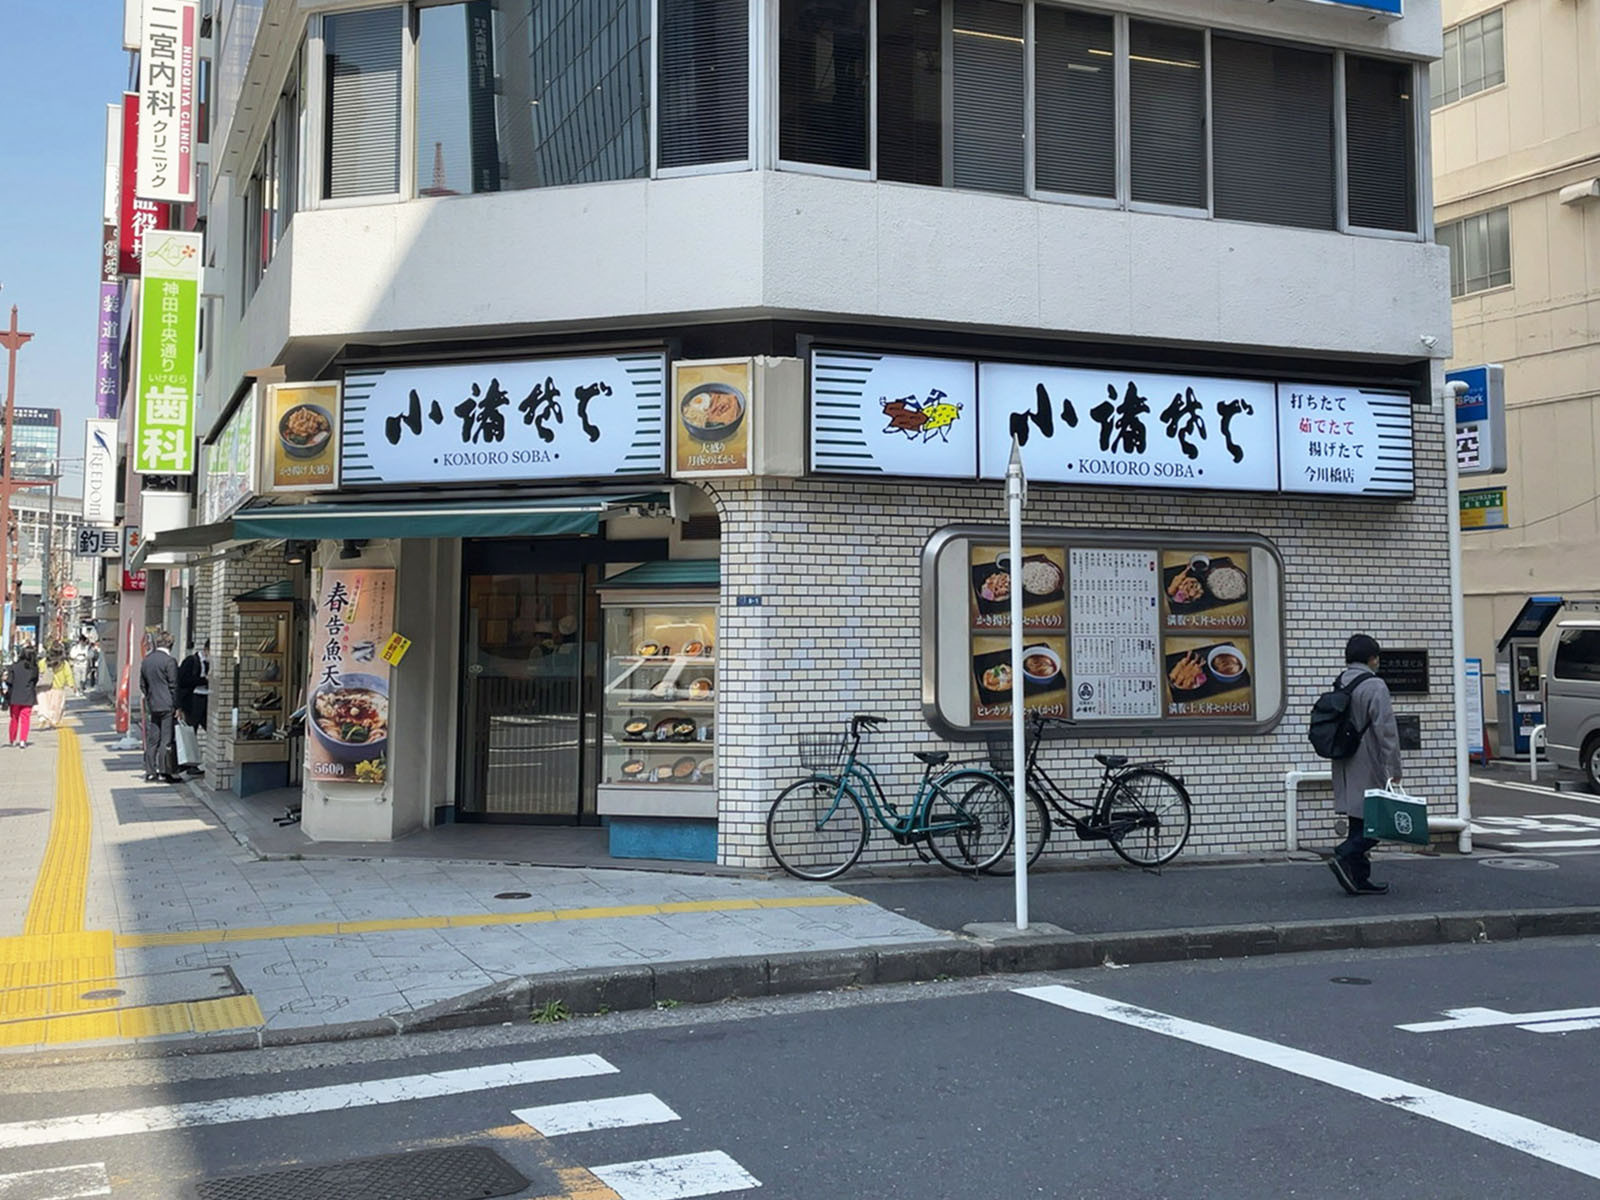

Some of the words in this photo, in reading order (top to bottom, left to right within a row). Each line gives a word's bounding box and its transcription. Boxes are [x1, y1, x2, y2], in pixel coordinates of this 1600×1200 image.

[181, 46, 193, 107] NINOMIYA
[147, 6, 177, 188] 二宮内科クリニック
[180, 111, 191, 154] CLINIC
[160, 281, 179, 373] 神田中央通り
[1290, 393, 1347, 411] 打ちたて
[143, 385, 188, 469] 歯科
[1299, 417, 1354, 435] 茹でたて
[443, 451, 509, 466] KOMORO
[511, 450, 552, 464] SOBA
[1309, 441, 1364, 458] 揚げたて
[1079, 459, 1151, 477] KOMORO
[1153, 461, 1196, 479] SOBA
[79, 530, 120, 553] 釣具
[320, 581, 349, 687] 春告魚天
[314, 762, 344, 775] 560円
